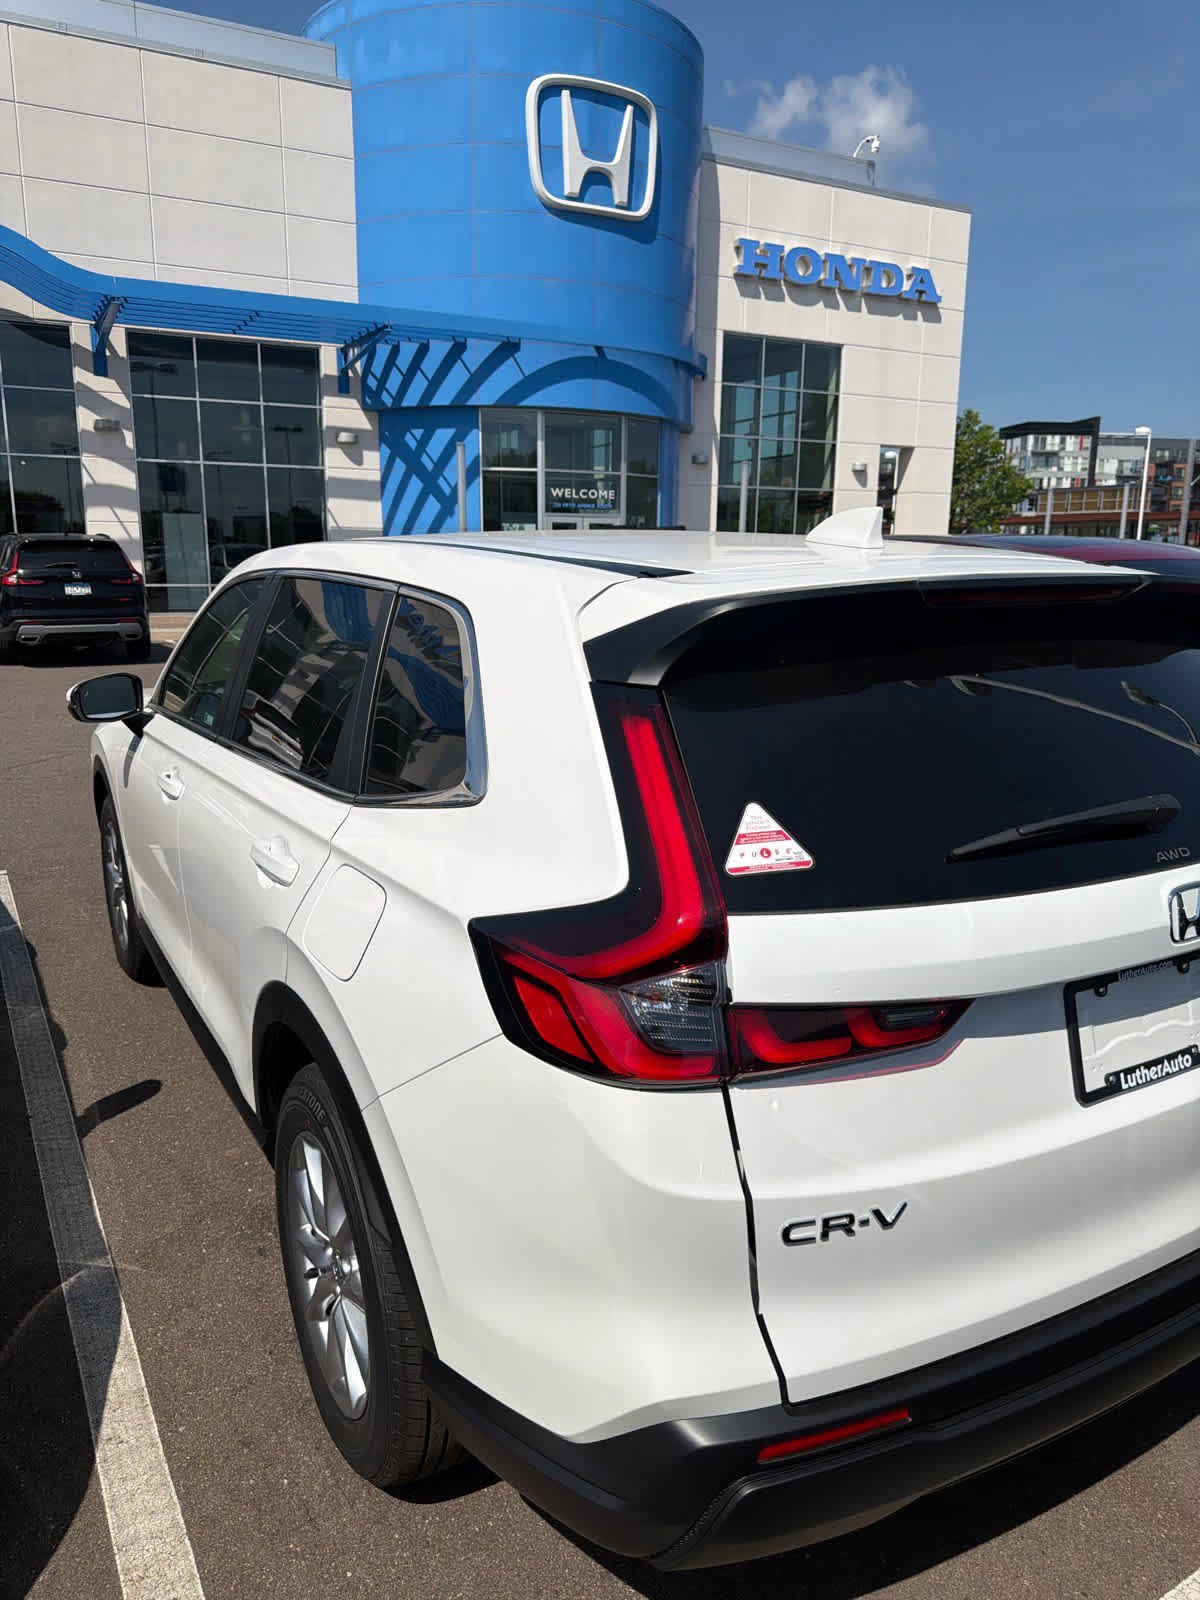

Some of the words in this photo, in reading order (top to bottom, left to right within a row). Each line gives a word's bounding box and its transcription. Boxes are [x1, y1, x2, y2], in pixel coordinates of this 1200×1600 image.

[733, 238, 942, 303] HONDA
[551, 487, 616, 500] WELCOME
[1156, 847, 1191, 864] AWD
[1120, 1053, 1192, 1090] LutherAuto
[780, 1200, 908, 1247] CR-V
